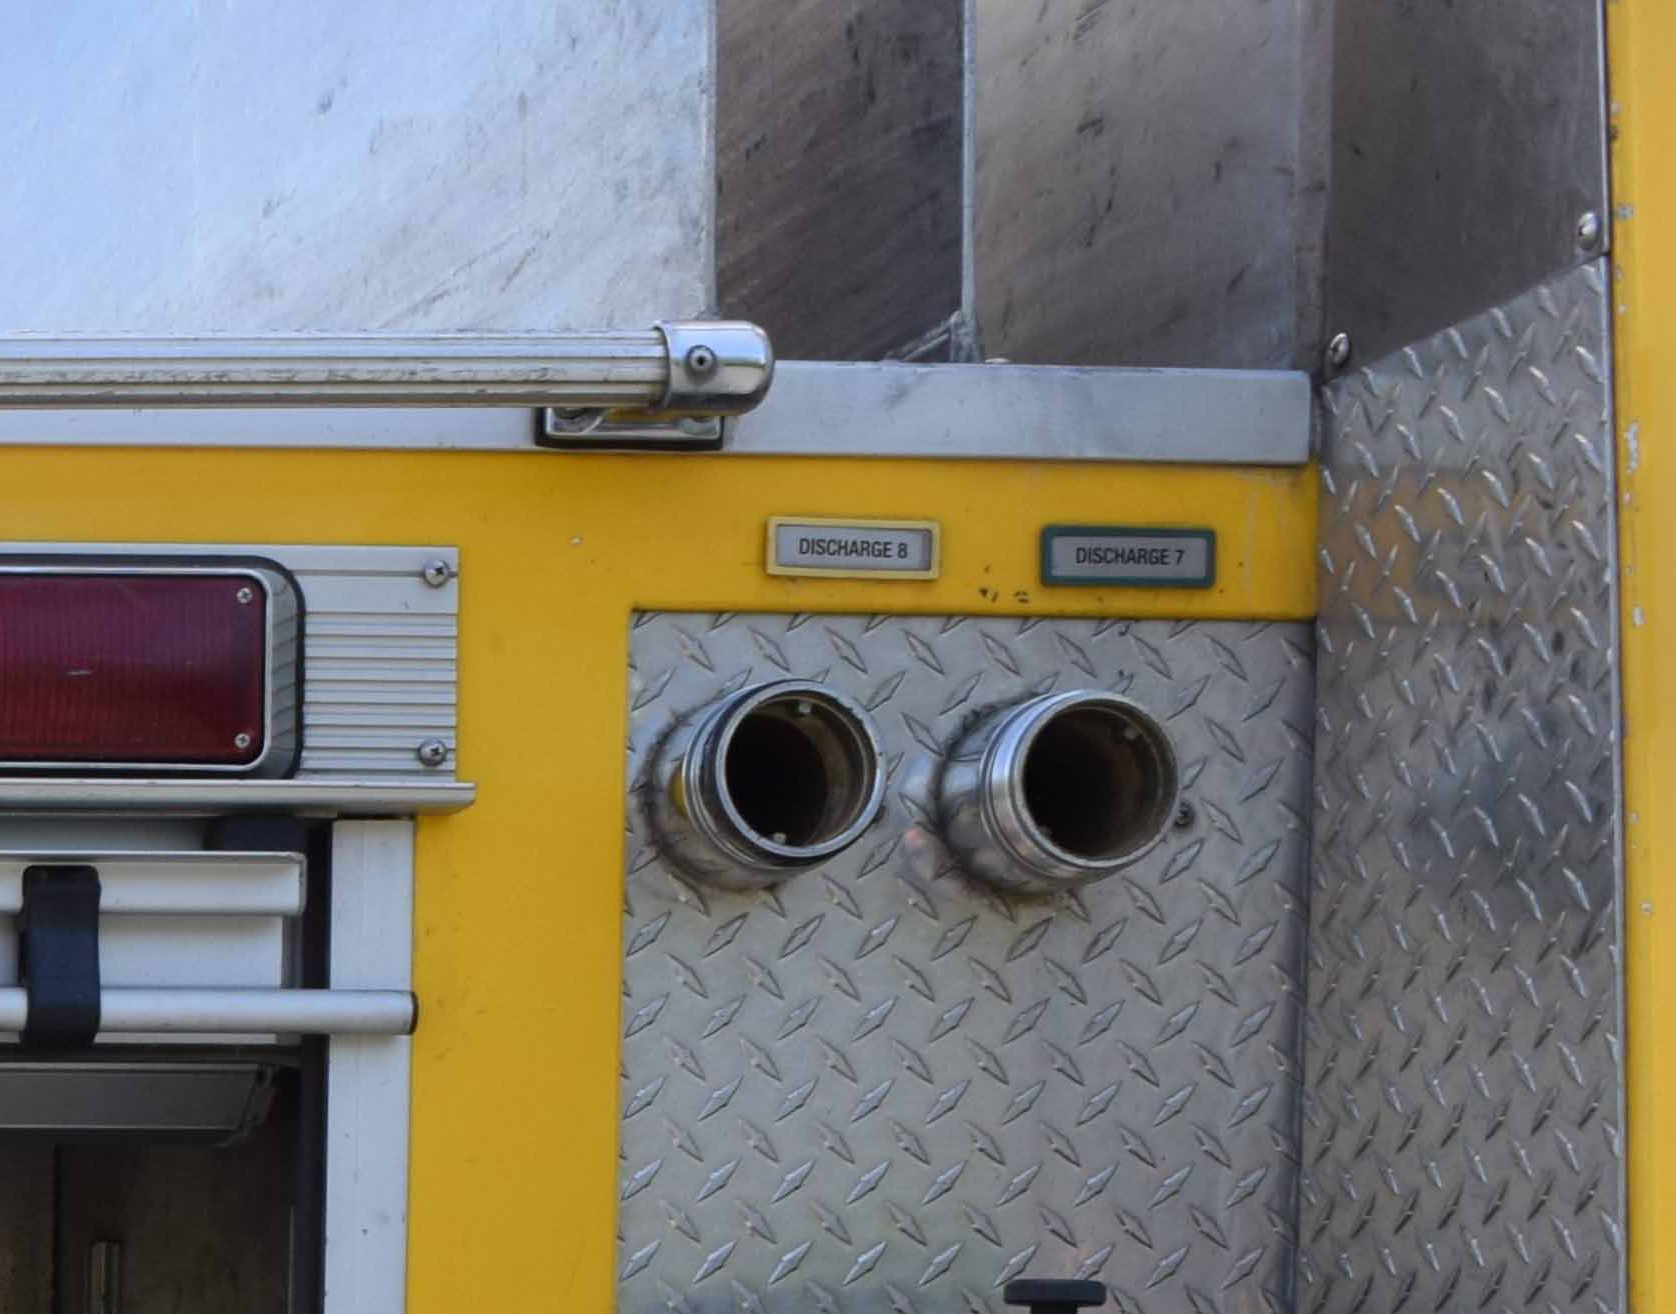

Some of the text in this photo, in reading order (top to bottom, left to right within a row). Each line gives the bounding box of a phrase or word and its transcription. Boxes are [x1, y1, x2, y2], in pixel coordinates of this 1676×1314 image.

[798, 537, 909, 560] DISCHARGE 8
[1075, 547, 1186, 567] DISCHARGE 7
